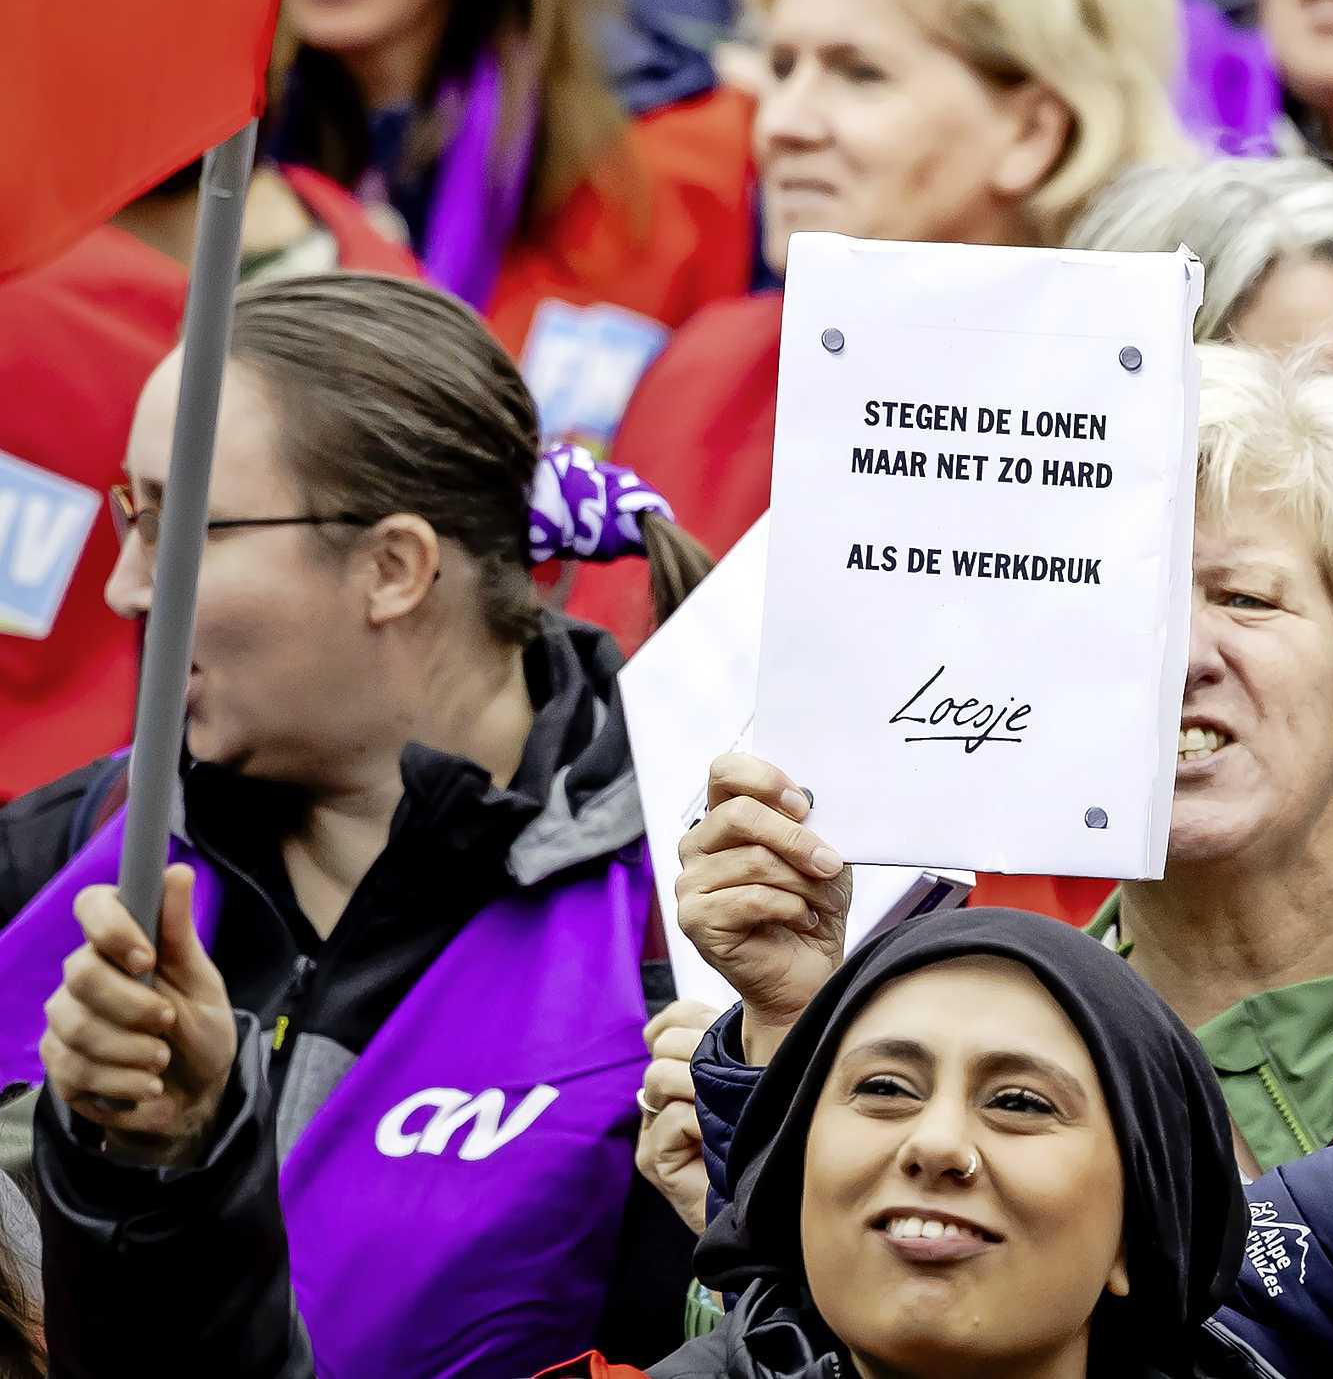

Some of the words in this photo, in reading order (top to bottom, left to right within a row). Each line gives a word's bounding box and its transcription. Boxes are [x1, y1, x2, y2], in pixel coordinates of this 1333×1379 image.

[864, 400, 967, 432] STEGEN
[977, 407, 1011, 435] DE
[1021, 410, 1107, 441] LONEN
[851, 447, 927, 479] MAAR
[936, 453, 988, 481] NET
[997, 457, 1032, 484] ZO
[1042, 460, 1113, 489] HARD
[846, 543, 897, 572] ALS
[907, 547, 942, 575] DE
[952, 550, 1102, 585] WERKDRUK
[889, 665, 1032, 754] Loesje
[375, 1083, 560, 1161] CNV
[1260, 1228, 1291, 1270] Alpe
